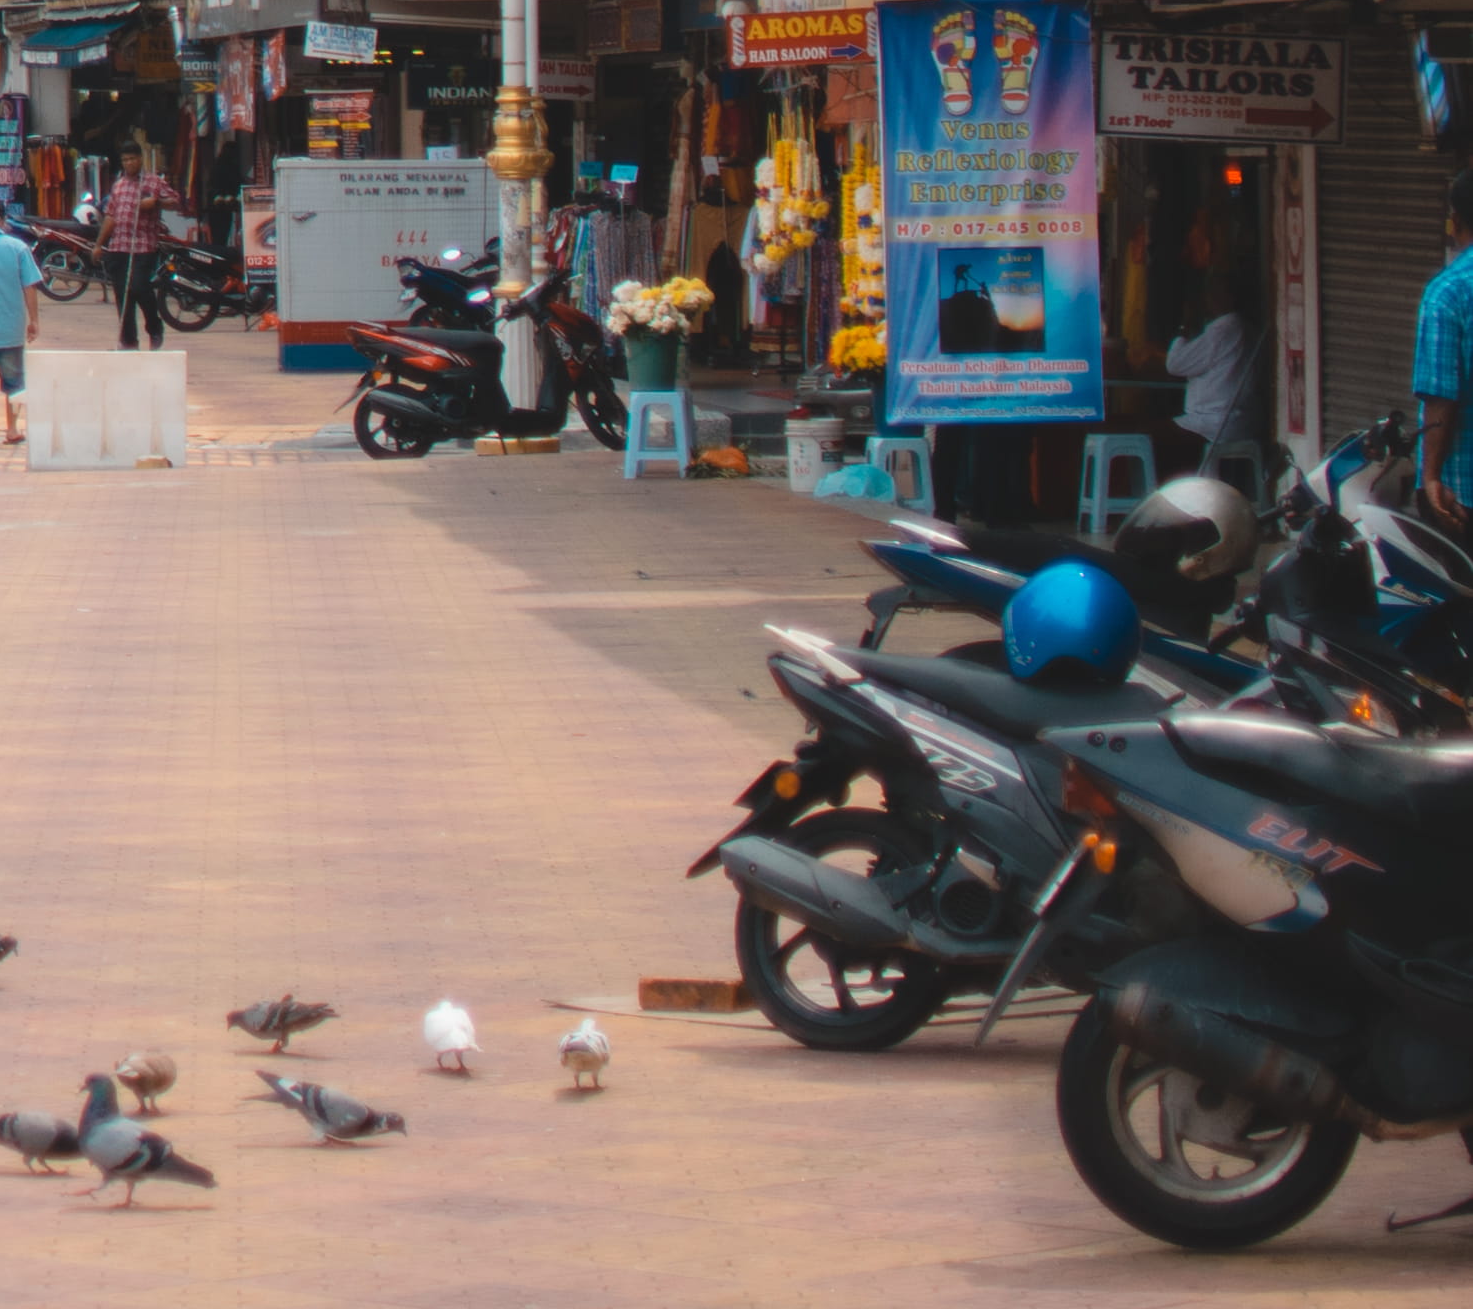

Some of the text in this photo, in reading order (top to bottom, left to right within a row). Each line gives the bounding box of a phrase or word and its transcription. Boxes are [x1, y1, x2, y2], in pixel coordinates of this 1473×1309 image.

[746, 13, 864, 41] AROMAS
[749, 45, 829, 63] HAIR SALOON
[1111, 34, 1333, 70] TRISHALA
[1126, 65, 1316, 98] TAILORS
[428, 85, 492, 99] INDIAN
[941, 120, 1031, 141] Venus
[1108, 115, 1175, 129] 1st Floor
[895, 148, 1080, 175] Reflexiology
[340, 173, 470, 183] DILARANG MENAMPAL
[344, 187, 380, 196] IKLAN
[387, 187, 420, 196] ANDA
[909, 178, 1066, 206] Enterprise
[896, 222, 934, 237] H/P
[953, 221, 1030, 236] 017-445
[1037, 220, 1083, 234] 0008
[900, 361, 961, 374] Persatuan
[964, 359, 1024, 375] Kebajikan
[919, 379, 956, 394] Thalai
[1018, 379, 1072, 395] Malaysia
[1246, 812, 1386, 874] ELIT
